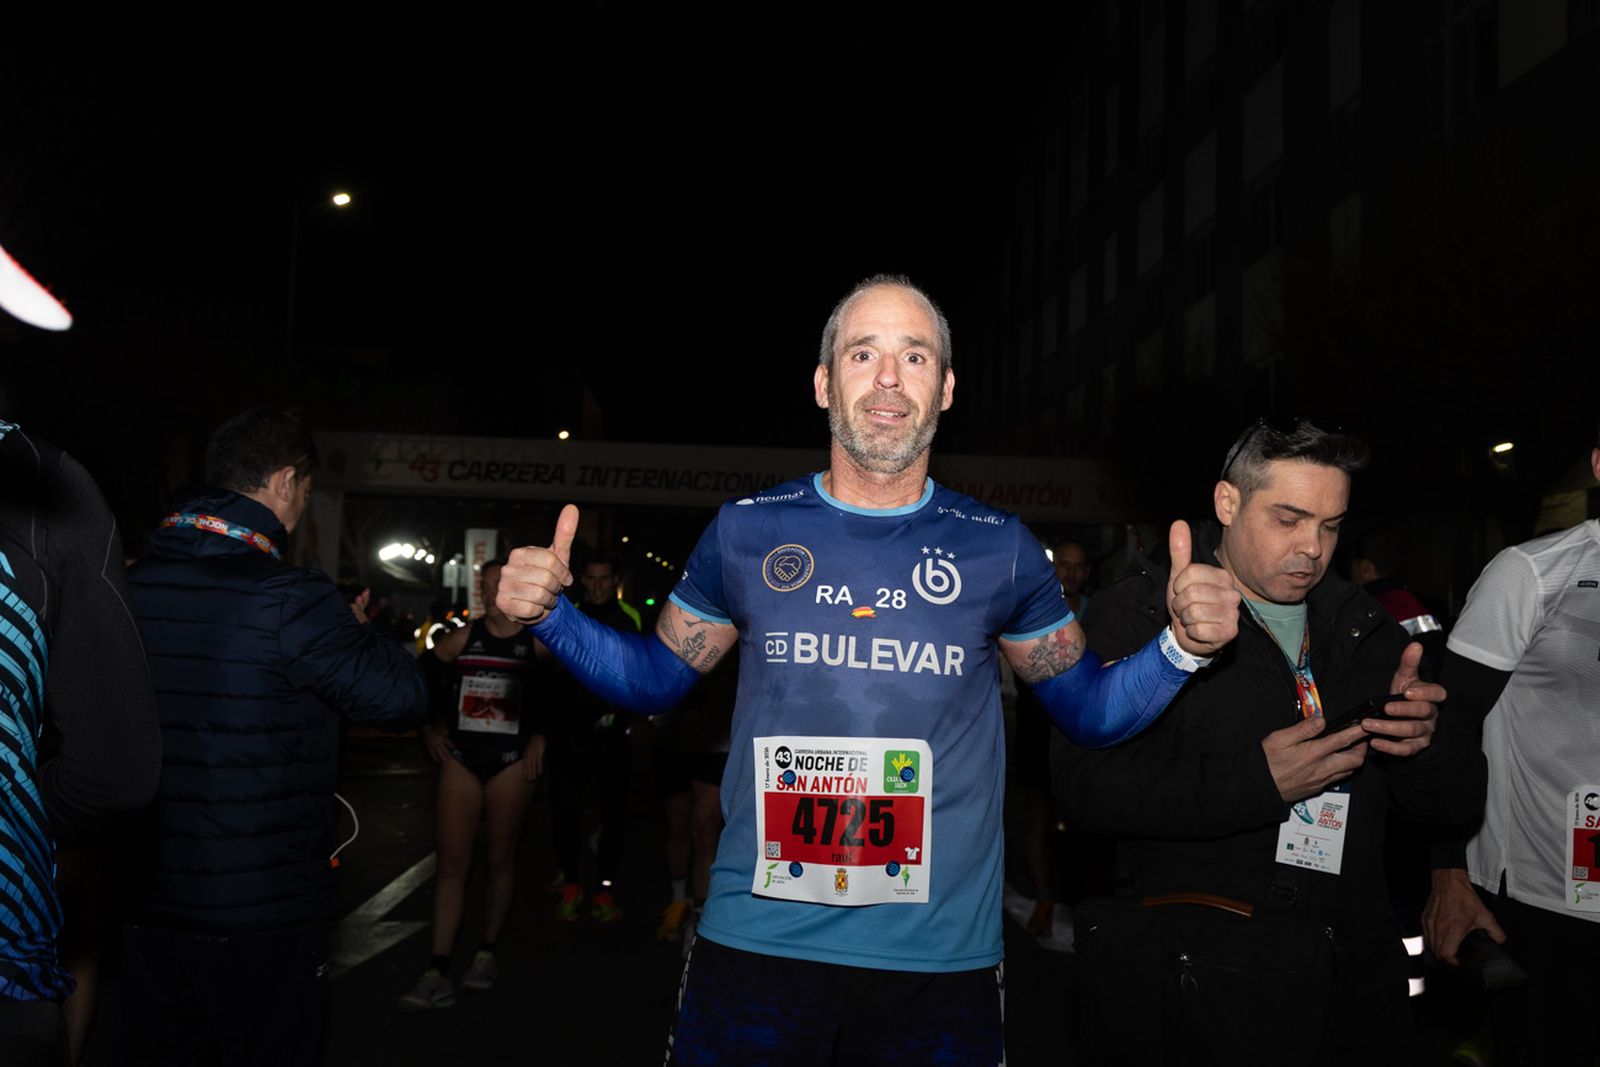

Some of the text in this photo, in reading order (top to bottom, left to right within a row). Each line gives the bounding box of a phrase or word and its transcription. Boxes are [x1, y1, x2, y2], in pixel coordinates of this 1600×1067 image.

[409, 453, 440, 482] 43
[448, 460, 565, 485] CARRERA
[755, 489, 804, 502] neumax
[815, 585, 907, 609] RA 28
[765, 632, 965, 676] CD BULEVAR
[775, 751, 792, 764] 43
[795, 756, 868, 772] NOCHE DE
[810, 773, 868, 793] ANTÓN
[791, 797, 895, 847] 4725
